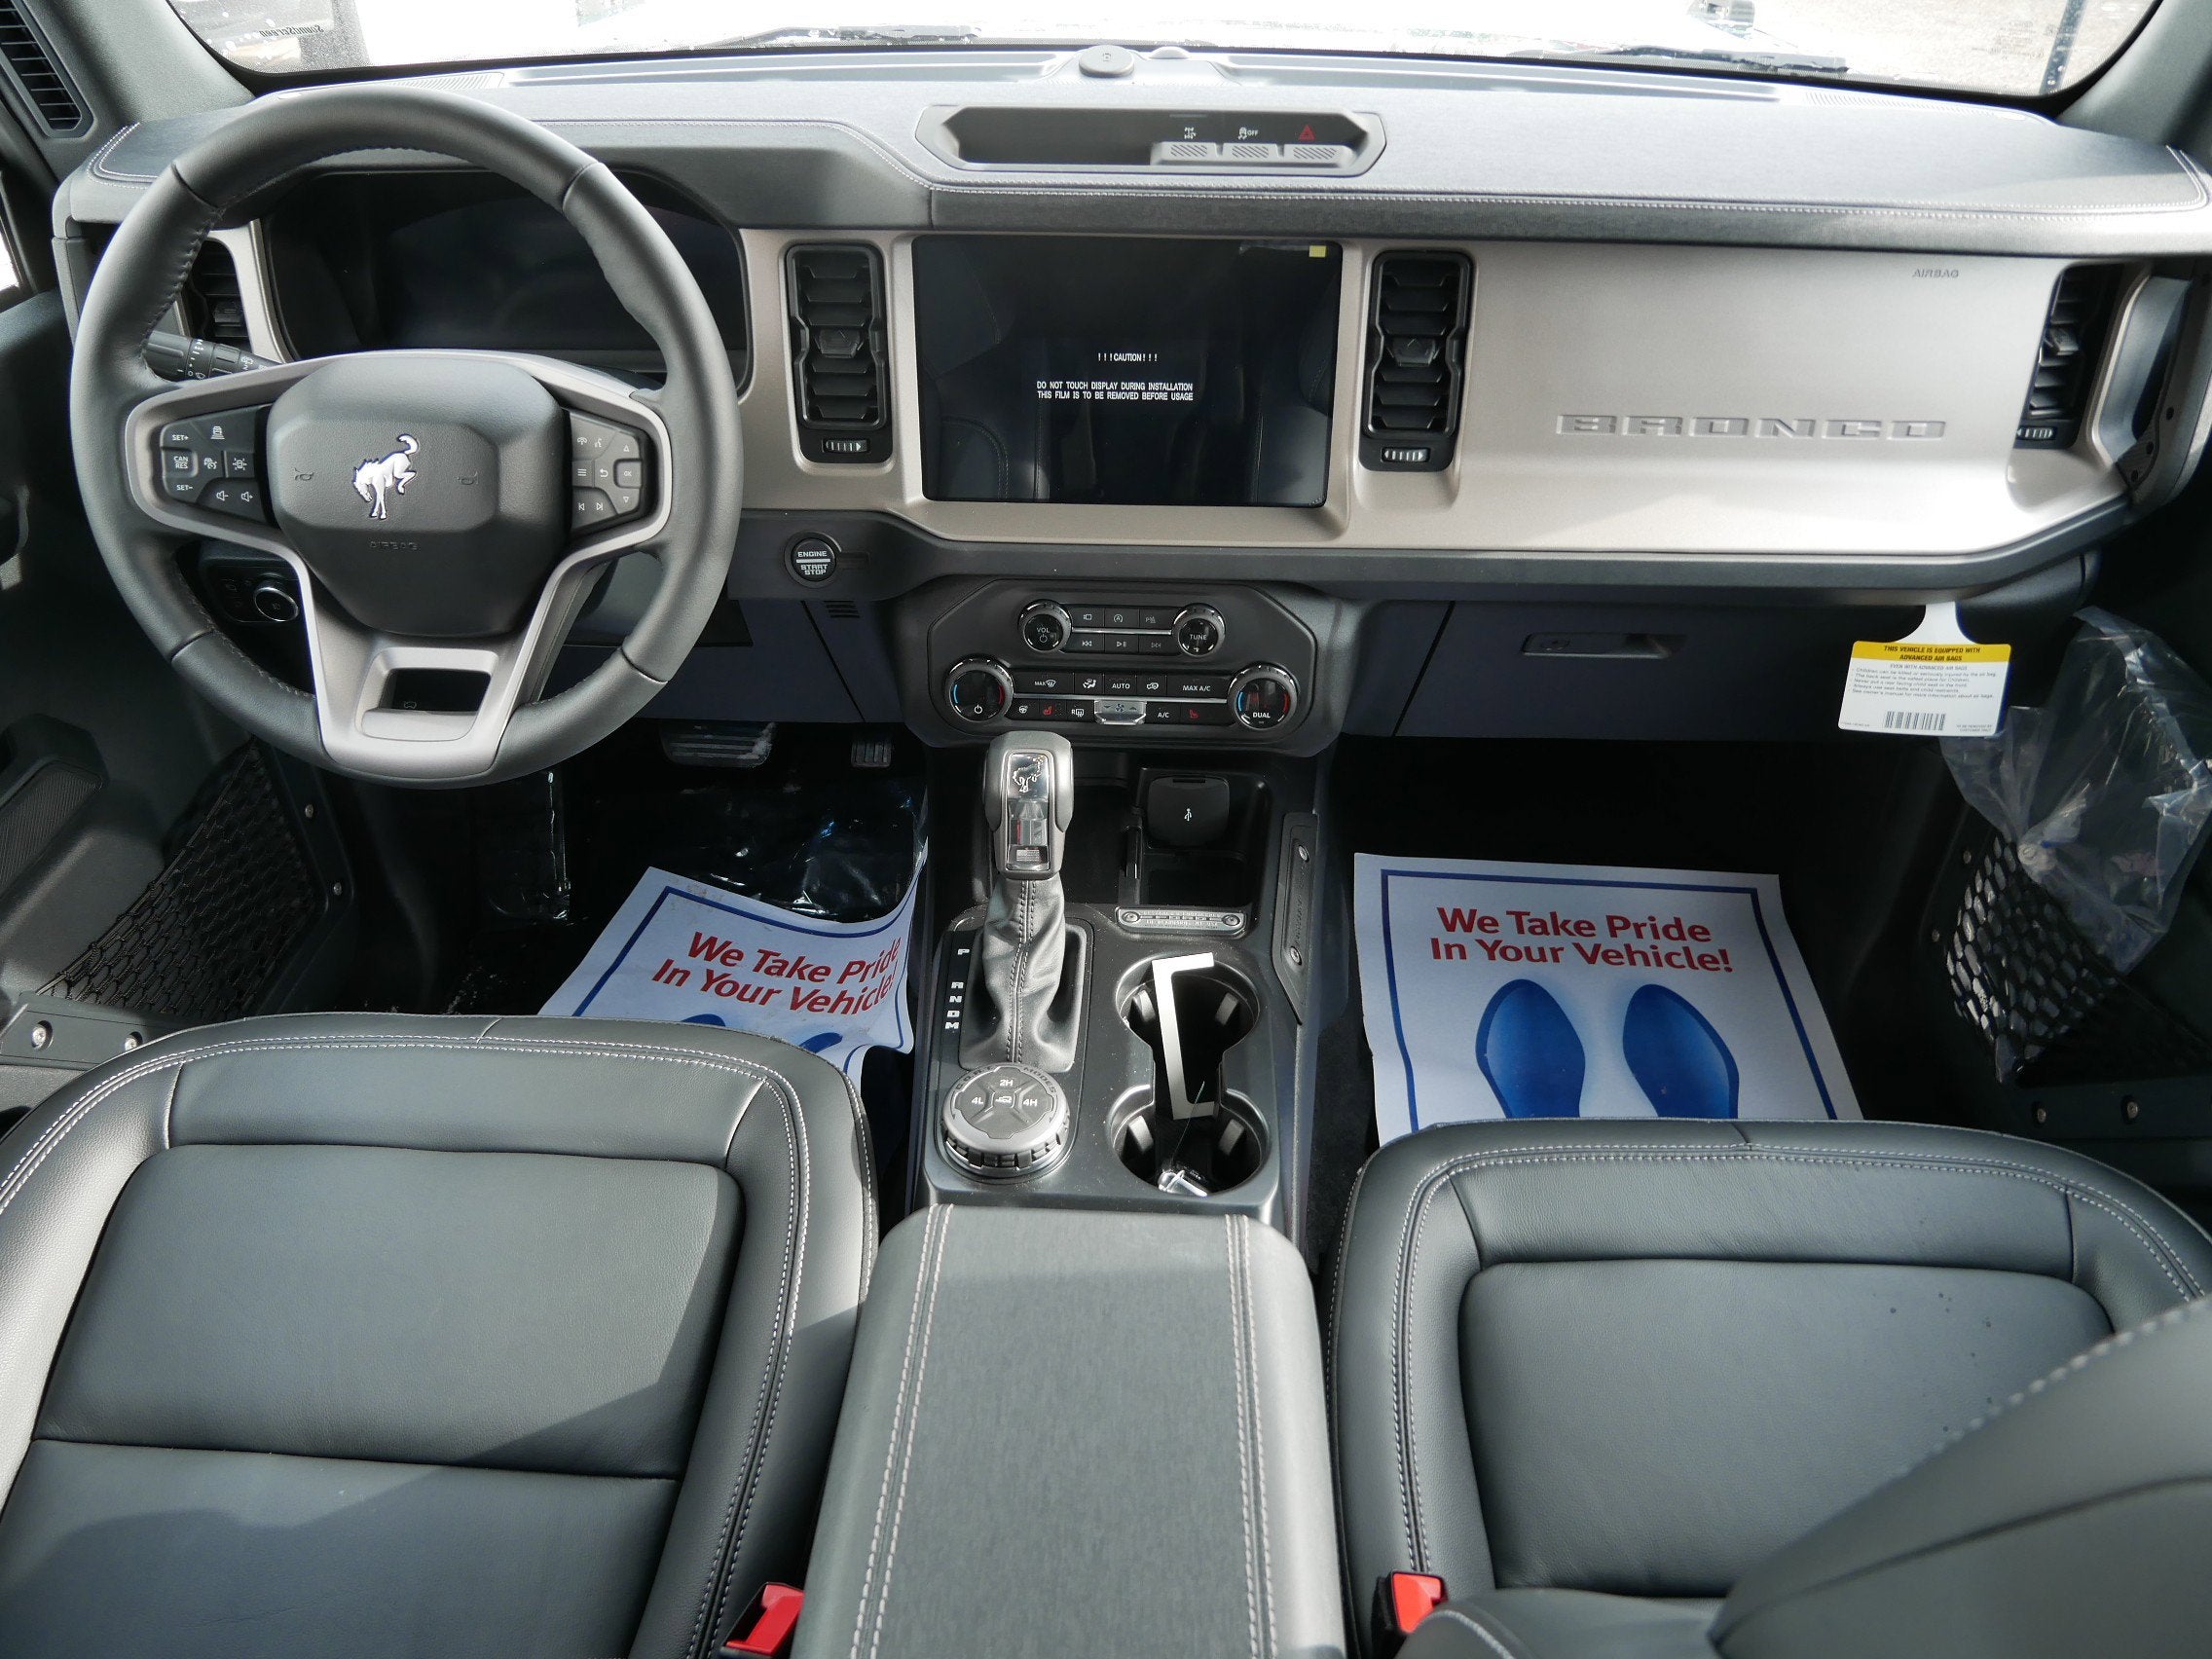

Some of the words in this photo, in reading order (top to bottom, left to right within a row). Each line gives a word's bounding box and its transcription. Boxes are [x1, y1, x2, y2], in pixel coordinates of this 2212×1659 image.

[1911, 268, 1959, 278] AIRBAG
[1037, 381, 1047, 389] DO
[1122, 382, 1145, 390] DURING
[1149, 383, 1194, 391] INSTALLATION
[1107, 391, 1139, 400] REMOVED
[1171, 392, 1194, 401] USAGE
[1556, 415, 1946, 440] BRONCO
[1436, 907, 1499, 934] We
[1505, 910, 1597, 938] Take
[1605, 914, 1713, 942] Pride
[687, 932, 745, 967] We
[752, 948, 832, 983] Take
[836, 938, 902, 984] Pride
[1430, 938, 1467, 960] In
[1475, 939, 1564, 964] Your
[1571, 942, 1733, 973] Vehicle!
[651, 958, 691, 987] In
[700, 969, 783, 1006] Your
[790, 960, 898, 1015] Vehicle!
